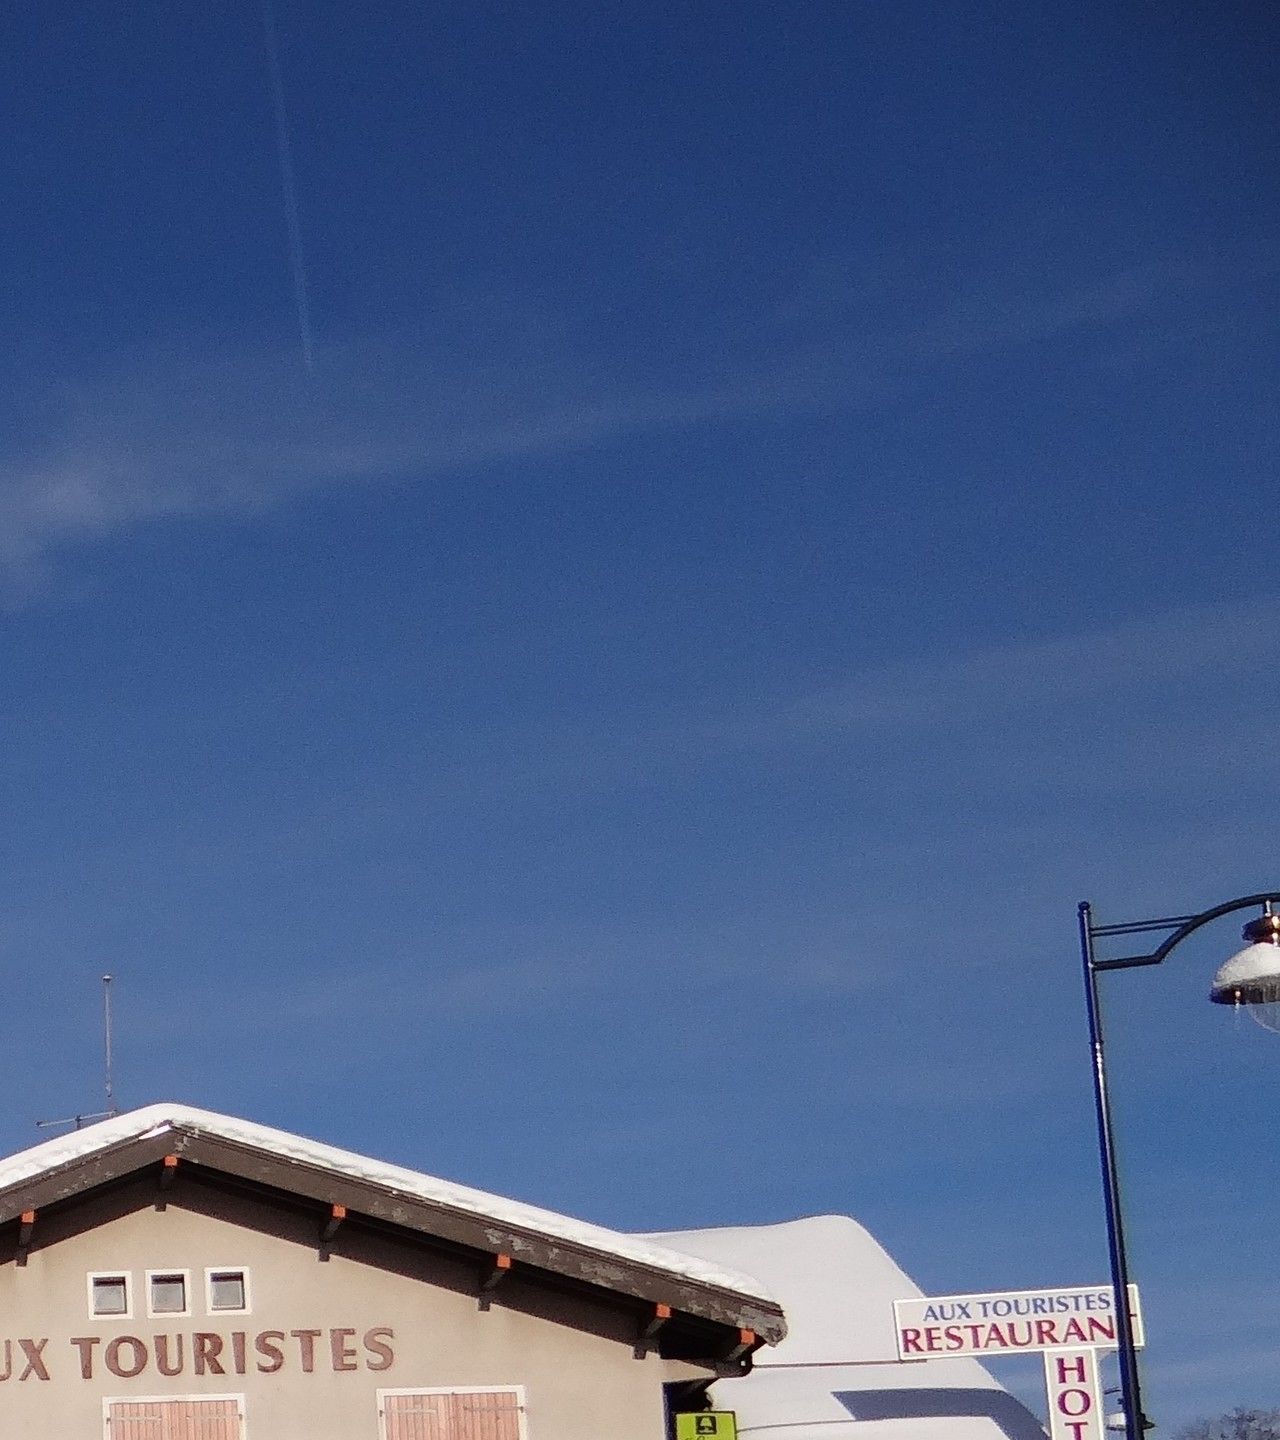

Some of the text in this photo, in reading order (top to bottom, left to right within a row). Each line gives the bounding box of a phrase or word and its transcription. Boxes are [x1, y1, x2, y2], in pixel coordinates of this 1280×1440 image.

[923, 1292, 1111, 1322] AUX TOURISTES
[901, 1313, 1138, 1353] RESTAURAN
[70, 1327, 396, 1380] TOURISTES
